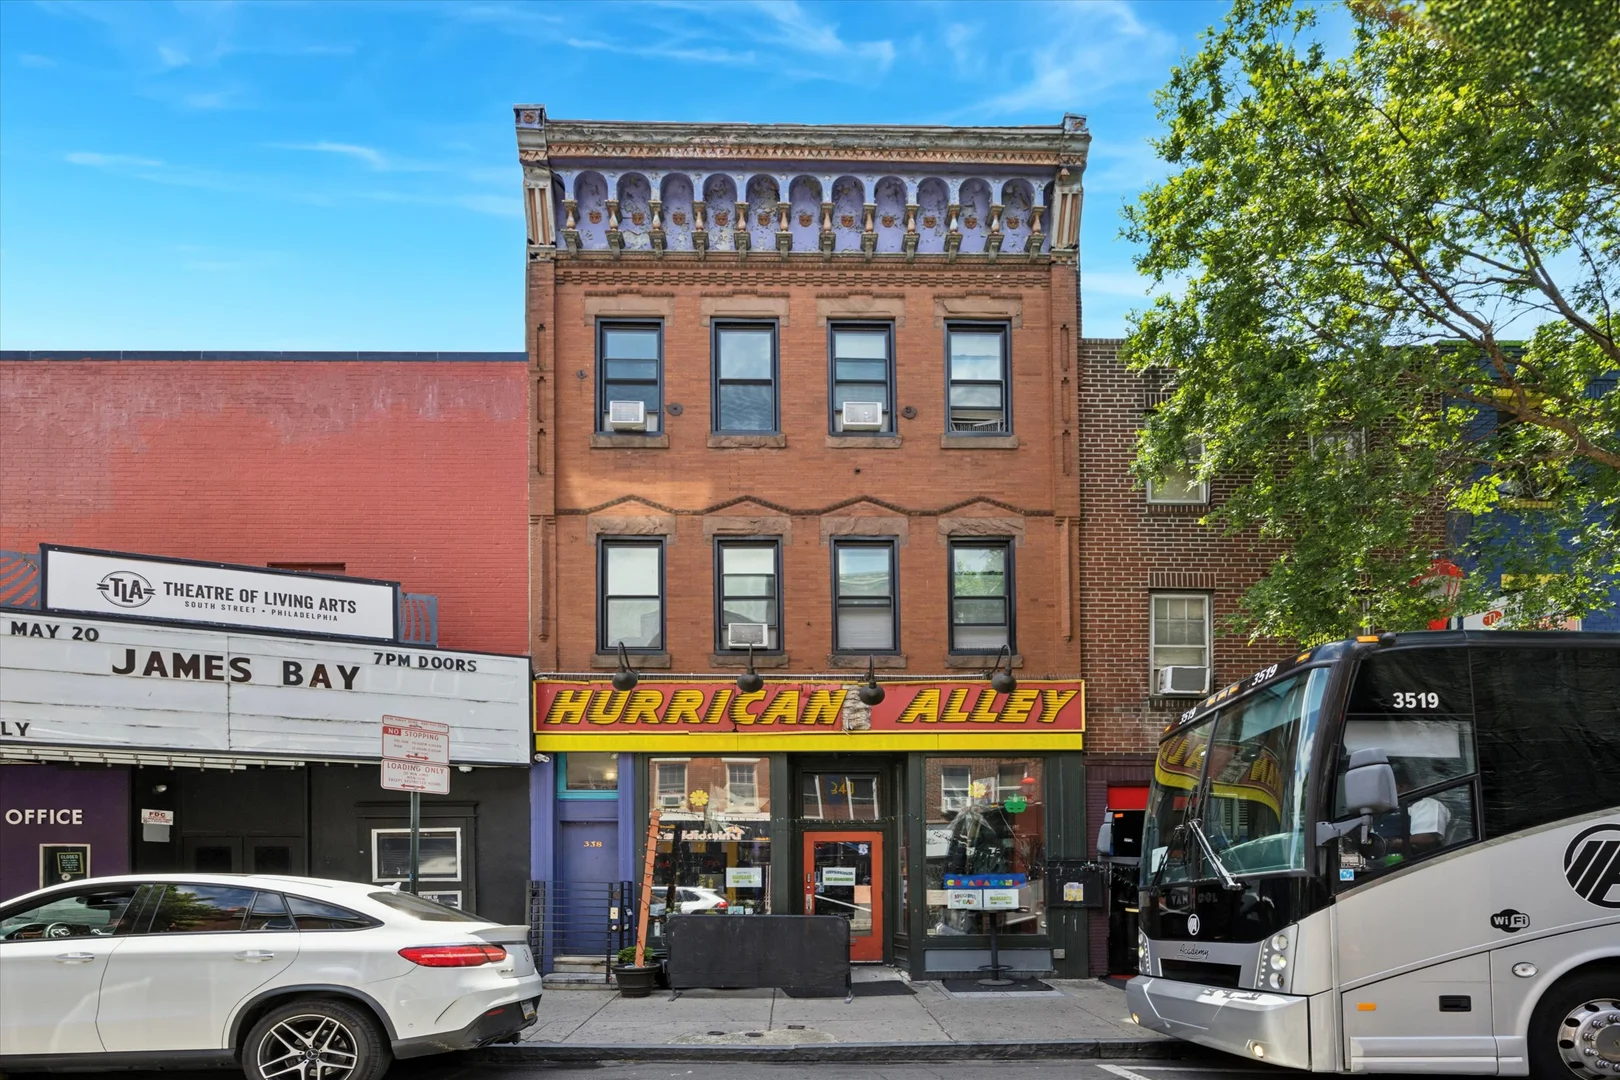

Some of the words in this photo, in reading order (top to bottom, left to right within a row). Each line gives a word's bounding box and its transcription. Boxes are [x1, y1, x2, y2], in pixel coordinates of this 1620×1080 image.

[109, 577, 144, 603] TLA
[163, 581, 234, 601] THEATRE
[239, 588, 259, 603] OF
[264, 591, 313, 609] LIVING
[319, 597, 356, 614] ARTS
[184, 600, 216, 610] SOUTH
[220, 604, 256, 613] STREET
[271, 609, 338, 621] PHILADELPHIA
[11, 621, 60, 639] MAY
[72, 626, 100, 642] 20
[112, 648, 253, 683] JAMES
[282, 660, 361, 690] BAY
[373, 652, 411, 668] 7PM
[419, 656, 477, 672] DOORS
[1251, 664, 1278, 686] 3519
[896, 688, 1079, 723] ALLEY
[1393, 692, 1439, 709] 3519
[405, 731, 439, 741] STOPPING
[387, 762, 421, 772] LOADING
[424, 766, 445, 775] ONLY
[5, 809, 83, 825] OFFICE
[1179, 943, 1210, 959] Academy
